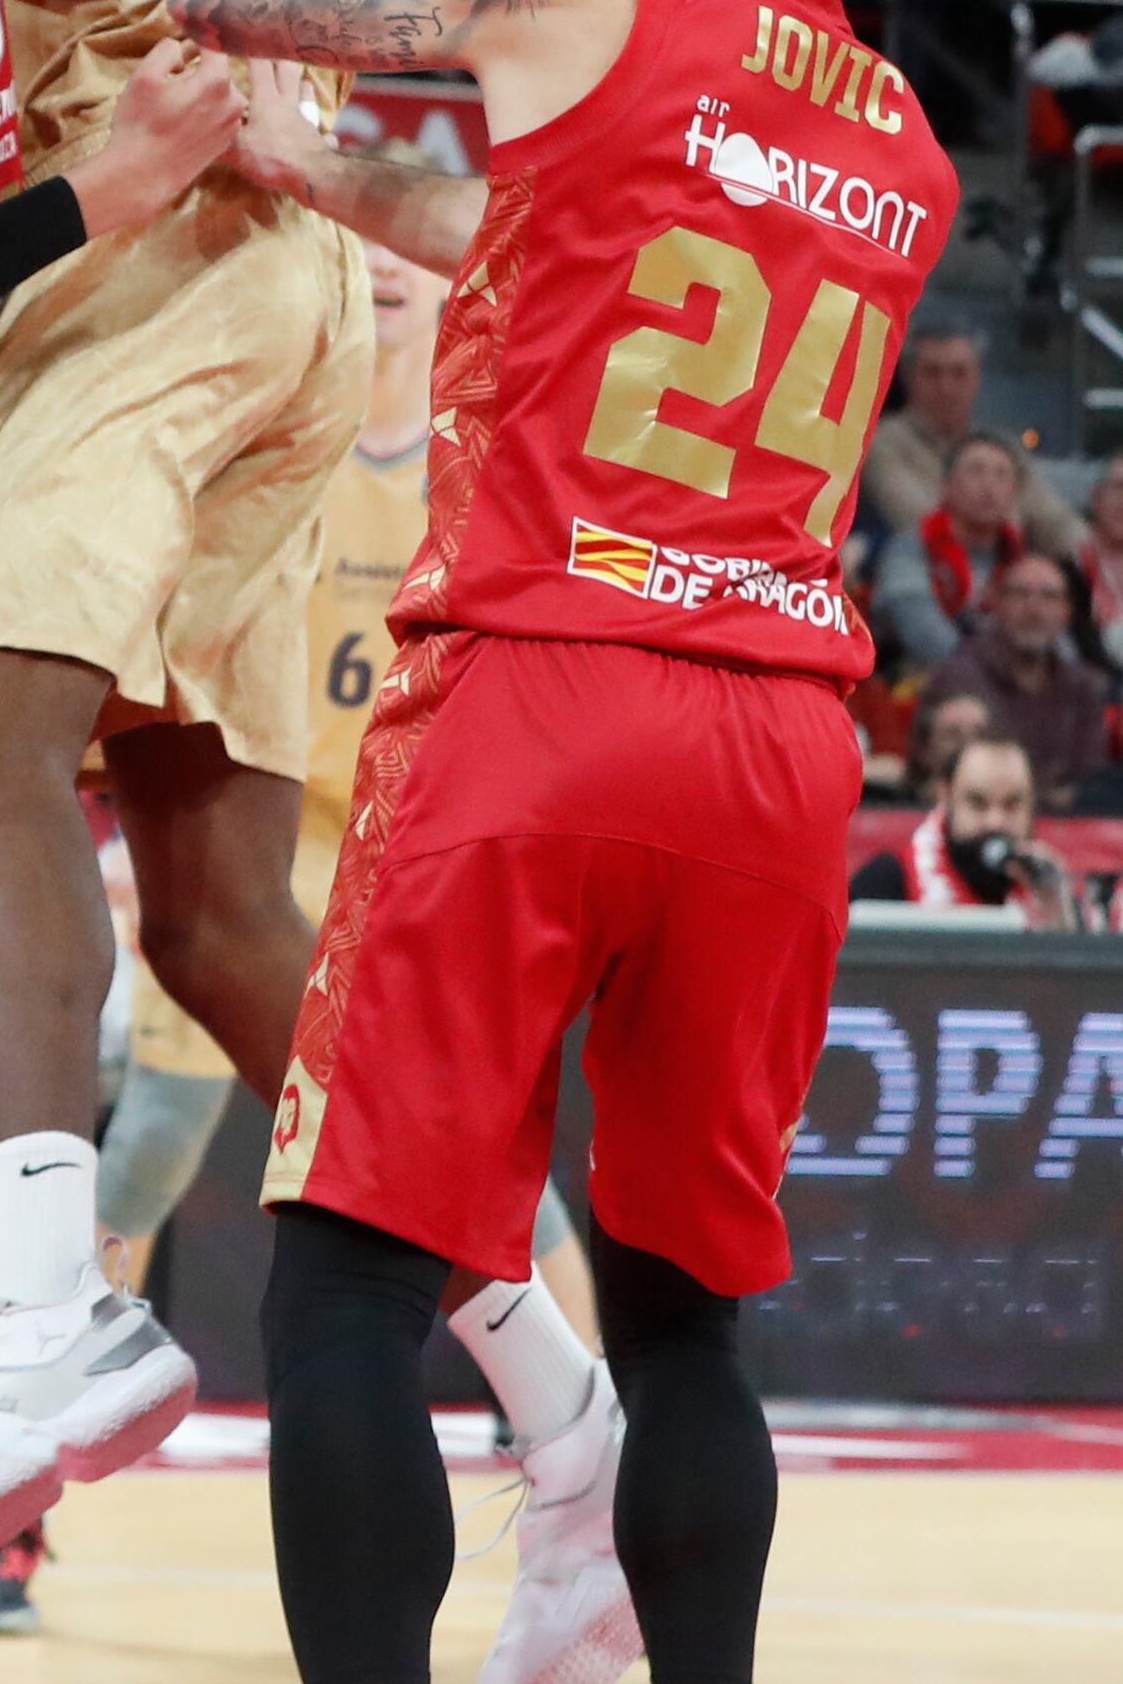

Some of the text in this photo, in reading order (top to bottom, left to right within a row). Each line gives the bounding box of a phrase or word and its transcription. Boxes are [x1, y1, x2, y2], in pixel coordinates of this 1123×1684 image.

[696, 94, 730, 118] air
[741, 5, 904, 135] JOVIC
[582, 226, 891, 549] 24
[649, 564, 714, 610] DE
[328, 631, 373, 708] 6
